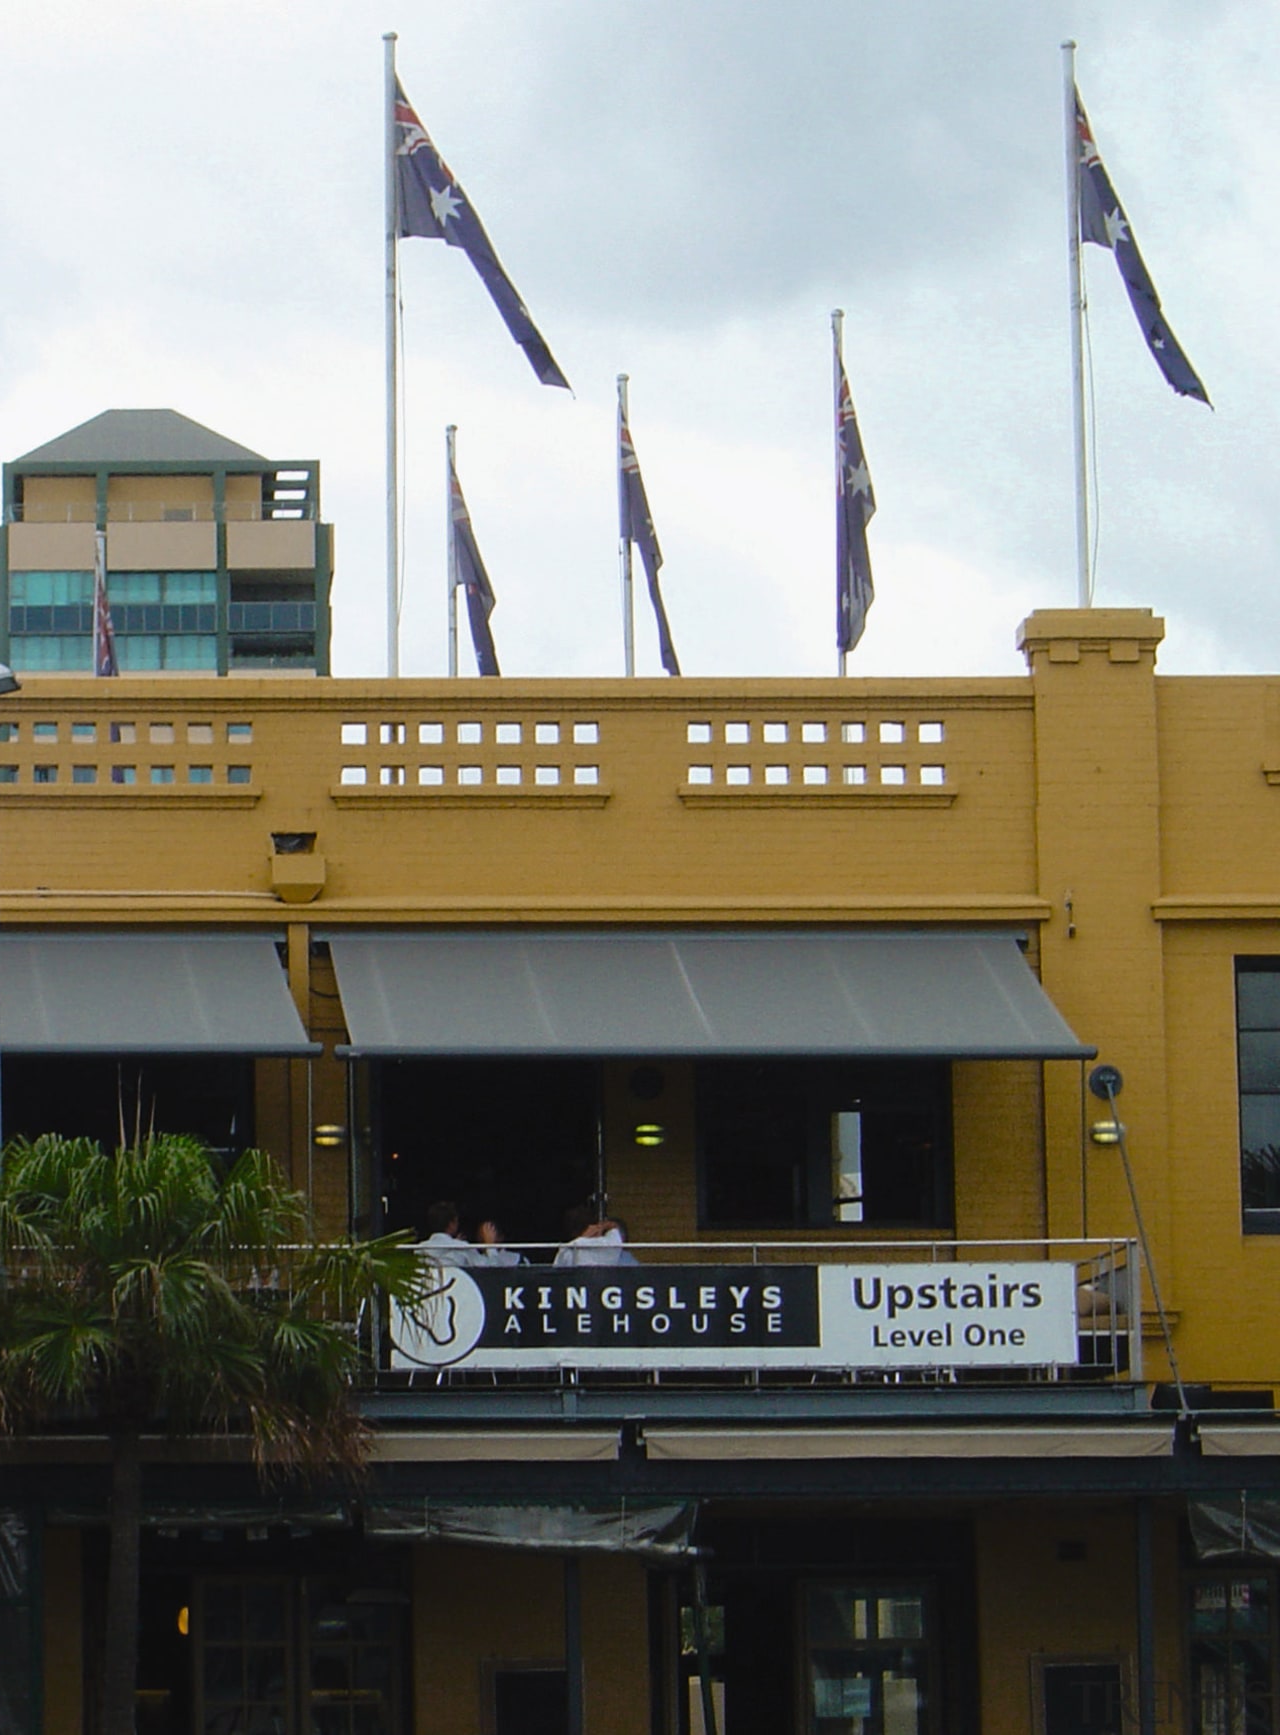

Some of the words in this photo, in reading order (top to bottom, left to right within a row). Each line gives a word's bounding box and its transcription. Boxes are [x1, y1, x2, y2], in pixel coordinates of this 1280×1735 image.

[504, 1286, 782, 1310] KINGSLEYS
[853, 1274, 1042, 1319] Upstairs
[504, 1313, 782, 1334] ALEHOUSE
[873, 1322, 952, 1348] Level
[964, 1323, 1026, 1347] One
